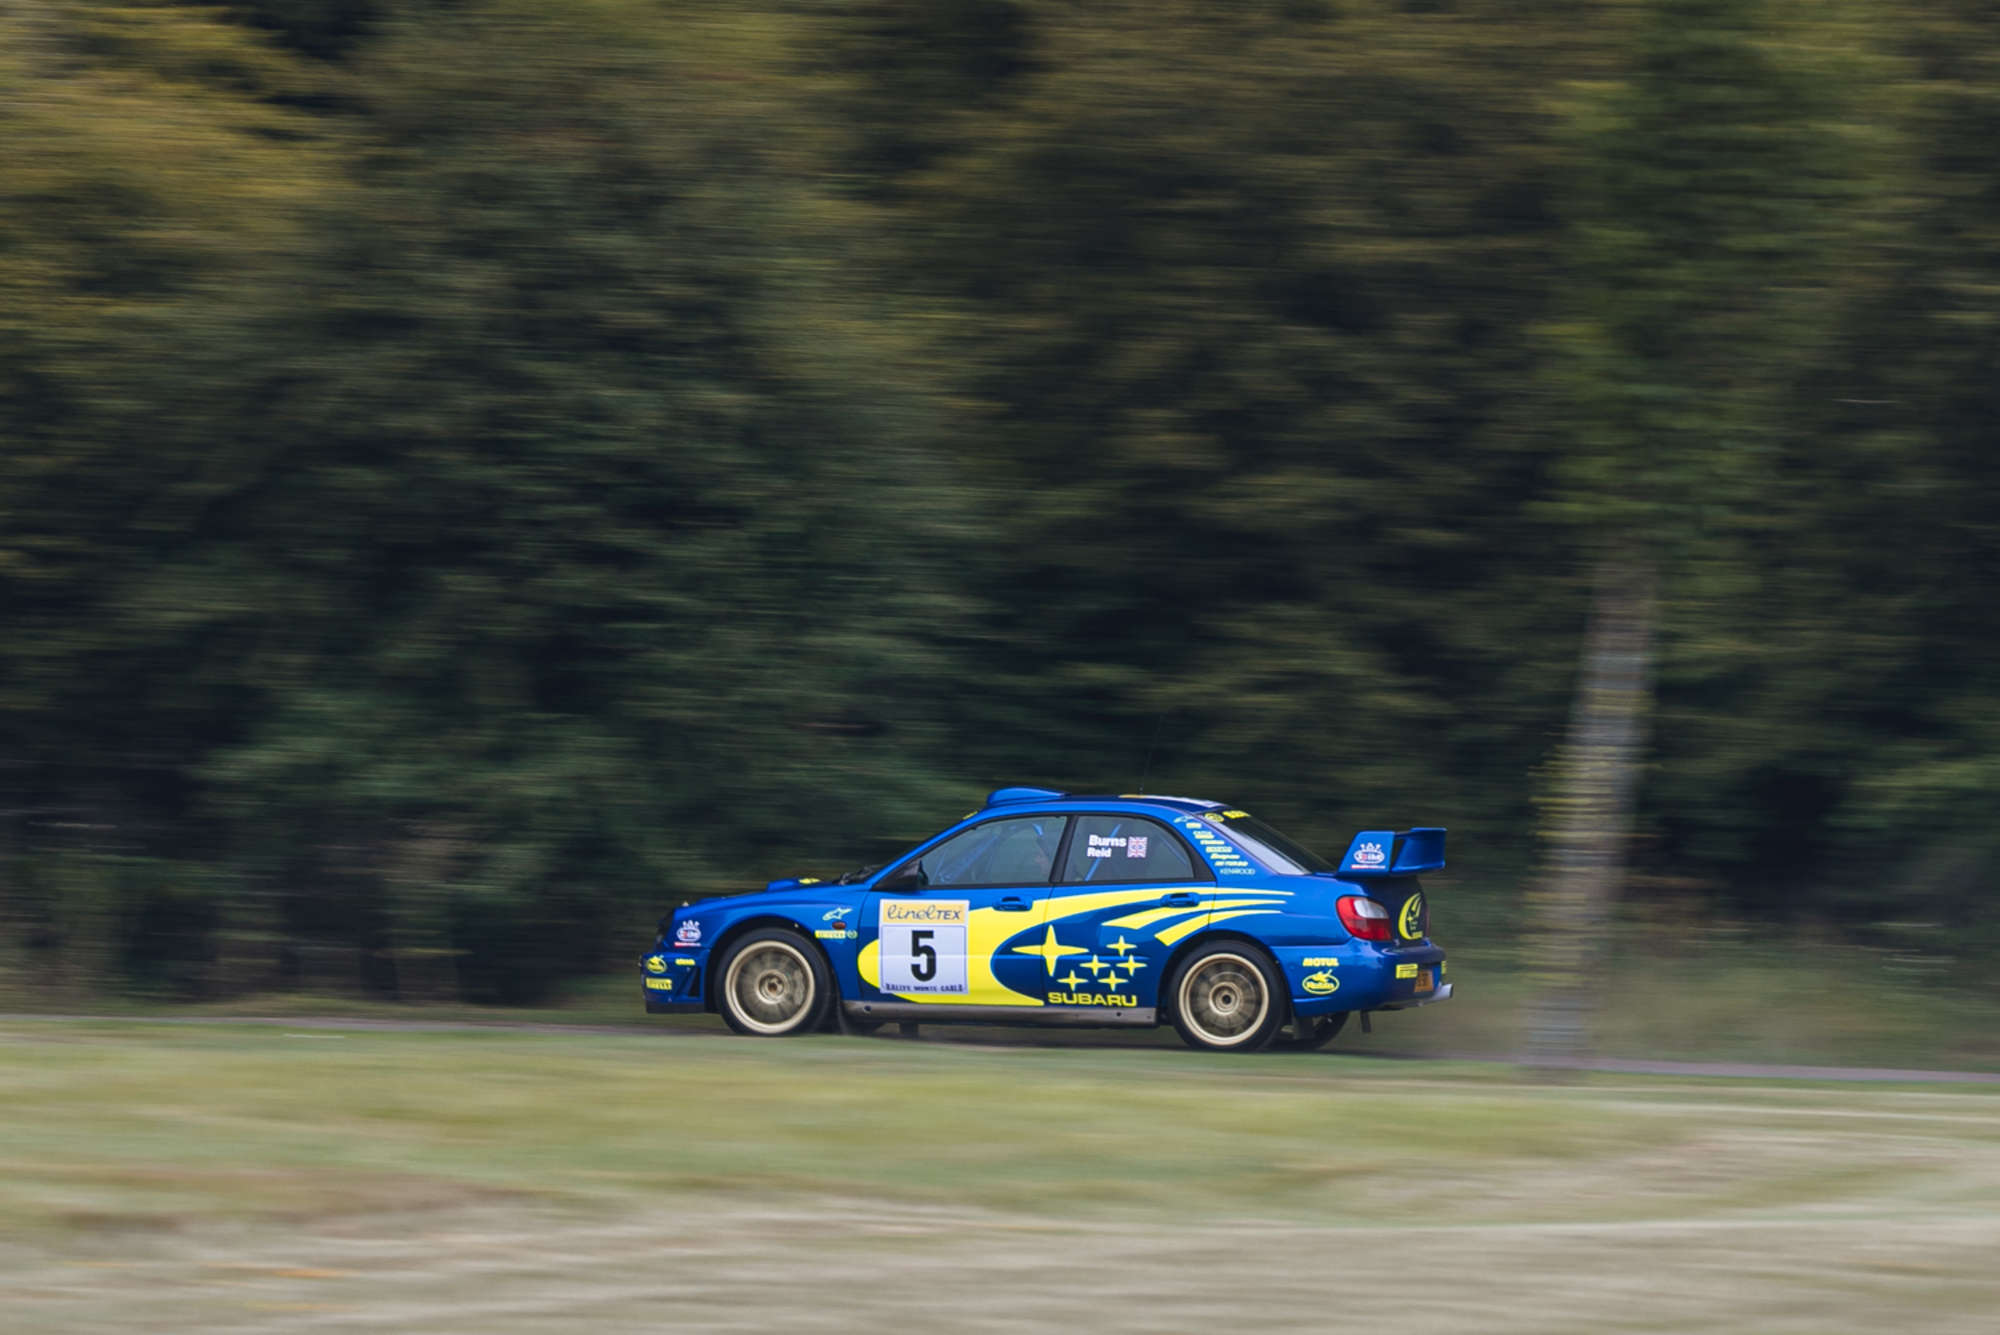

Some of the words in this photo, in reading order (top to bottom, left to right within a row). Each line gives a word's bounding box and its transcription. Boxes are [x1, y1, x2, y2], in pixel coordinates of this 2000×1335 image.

[1088, 834, 1127, 847] Burns
[1087, 847, 1112, 858] Reid
[911, 930, 937, 982] 5
[1302, 957, 1340, 967] MOTUL
[1048, 992, 1137, 1007] SUBARU
